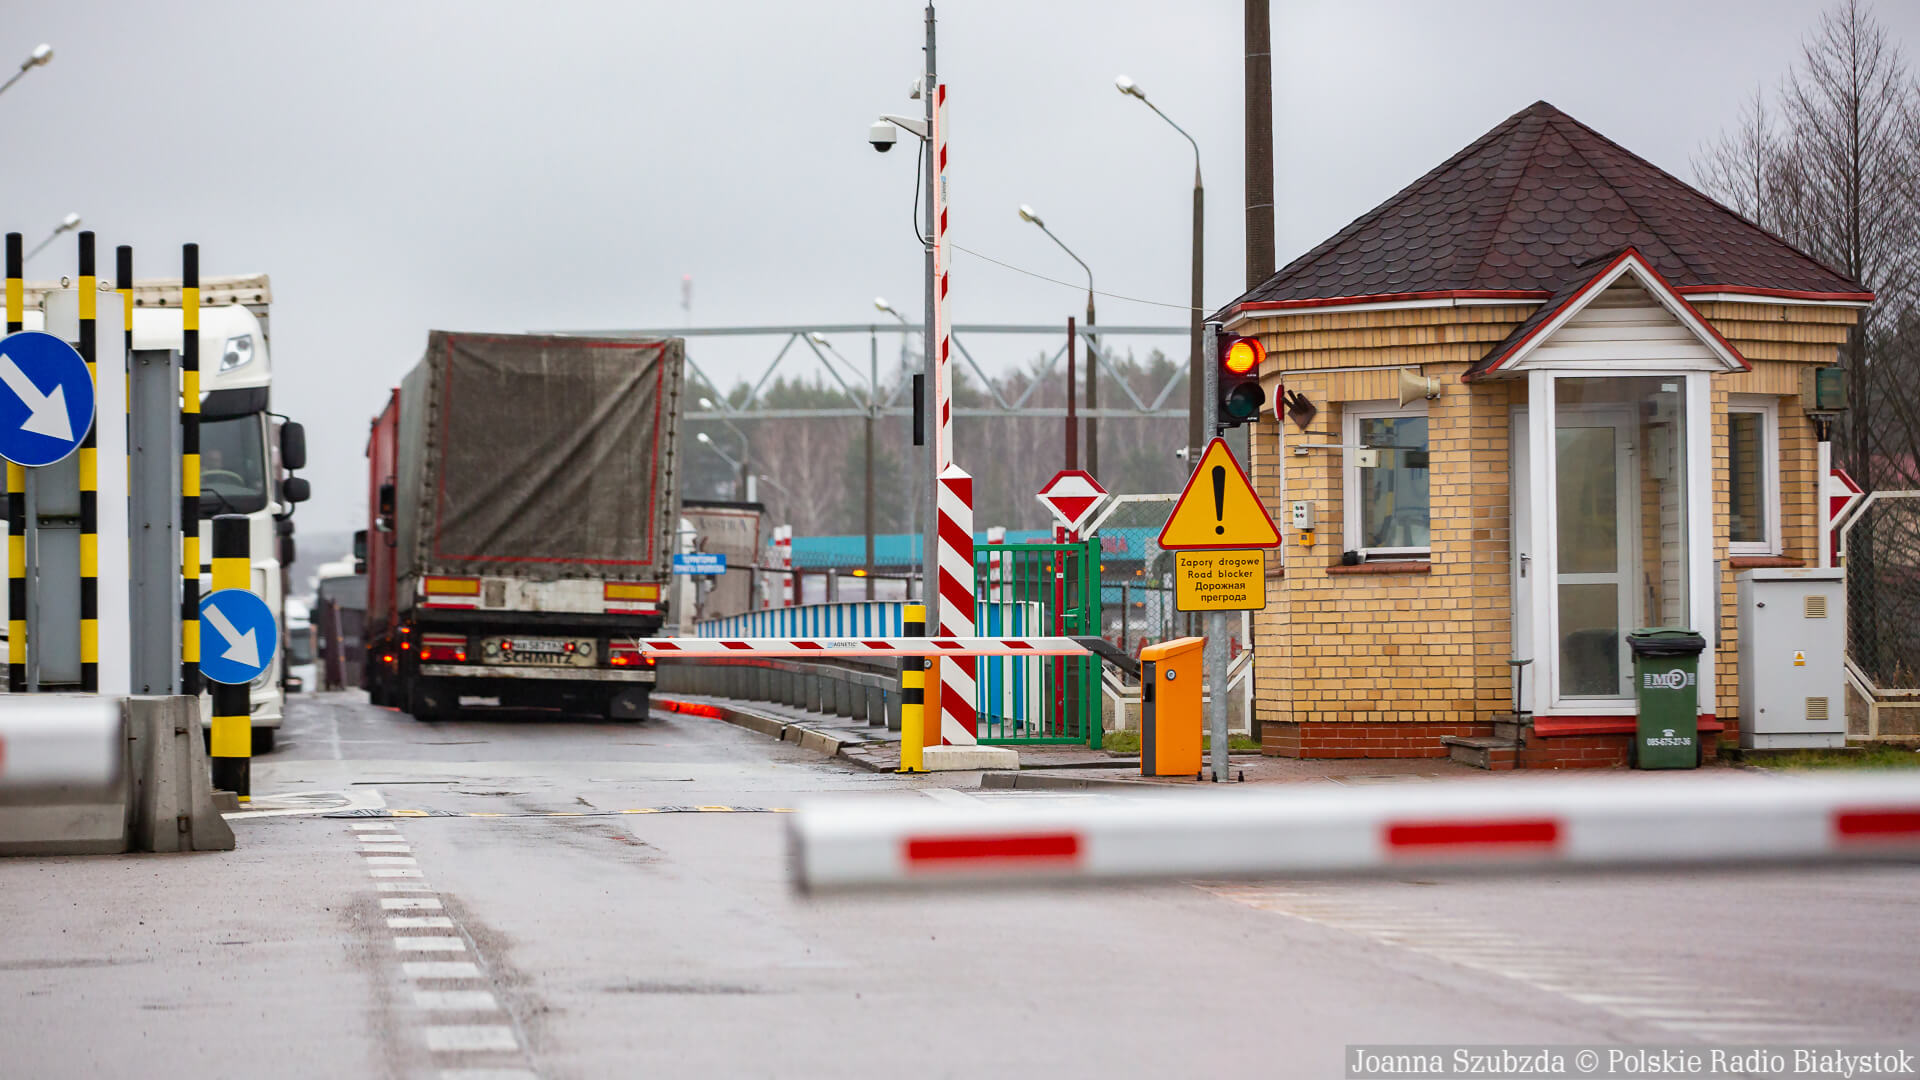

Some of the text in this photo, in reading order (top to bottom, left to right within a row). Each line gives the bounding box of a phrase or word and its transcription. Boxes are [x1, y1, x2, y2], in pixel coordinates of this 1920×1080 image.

[1181, 557, 1260, 568] Zapory drogowe
[1187, 569, 1253, 579] Road blocker
[1195, 581, 1246, 592] Дорожная
[1200, 594, 1247, 603] прегрода
[503, 652, 574, 664] SCHMITZ
